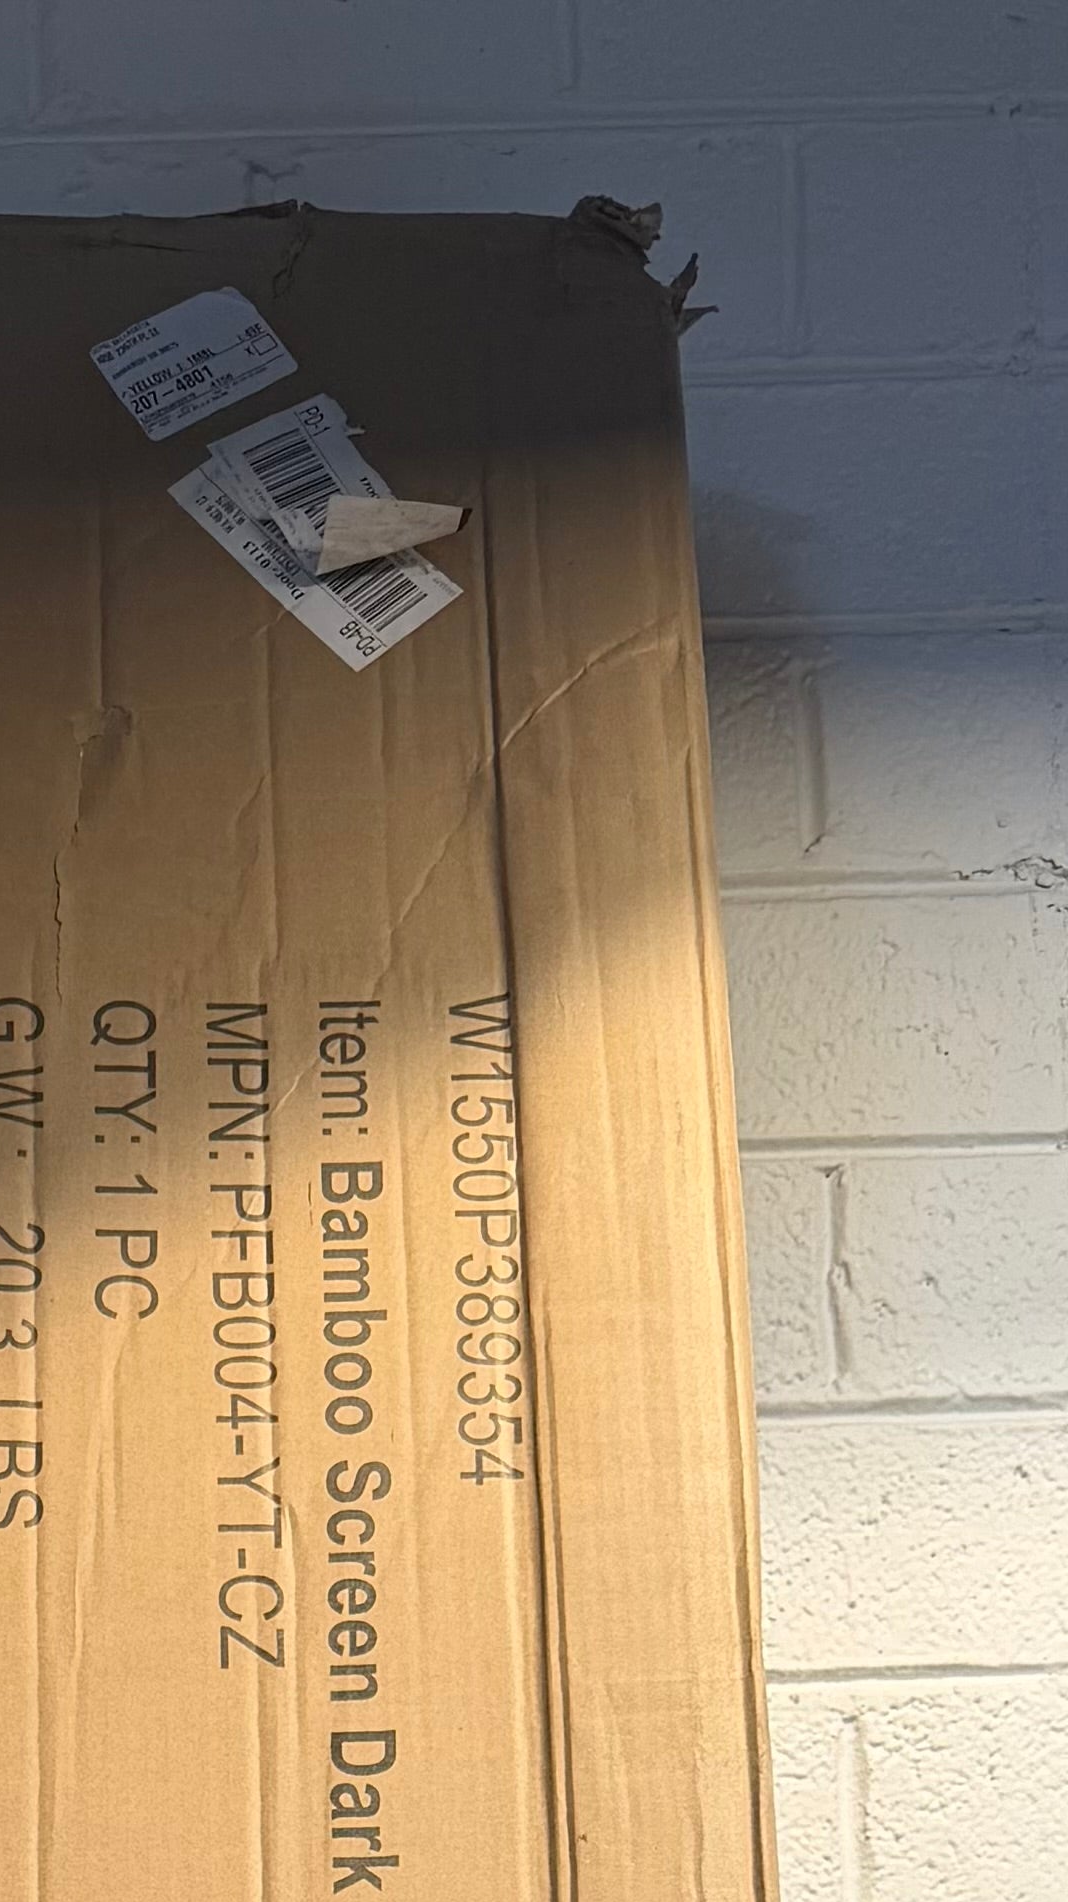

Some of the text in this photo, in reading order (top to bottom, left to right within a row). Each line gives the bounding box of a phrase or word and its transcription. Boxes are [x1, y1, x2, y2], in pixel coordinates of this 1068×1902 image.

[127, 367, 174, 396] YELLOW
[298, 403, 331, 438] PD-1
[239, 538, 274, 570] 0113
[338, 617, 381, 659] PD-4B
[318, 999, 381, 1138] Item:
[91, 1001, 158, 1321] QTY: 1 PC
[447, 990, 525, 1489] W1550P389354
[205, 1001, 285, 1672] MPN: PFB004-YT-CZ
[320, 1162, 390, 1437] Bamboo
[324, 1459, 391, 1705] Screen
[330, 1728, 397, 1893] Dark
